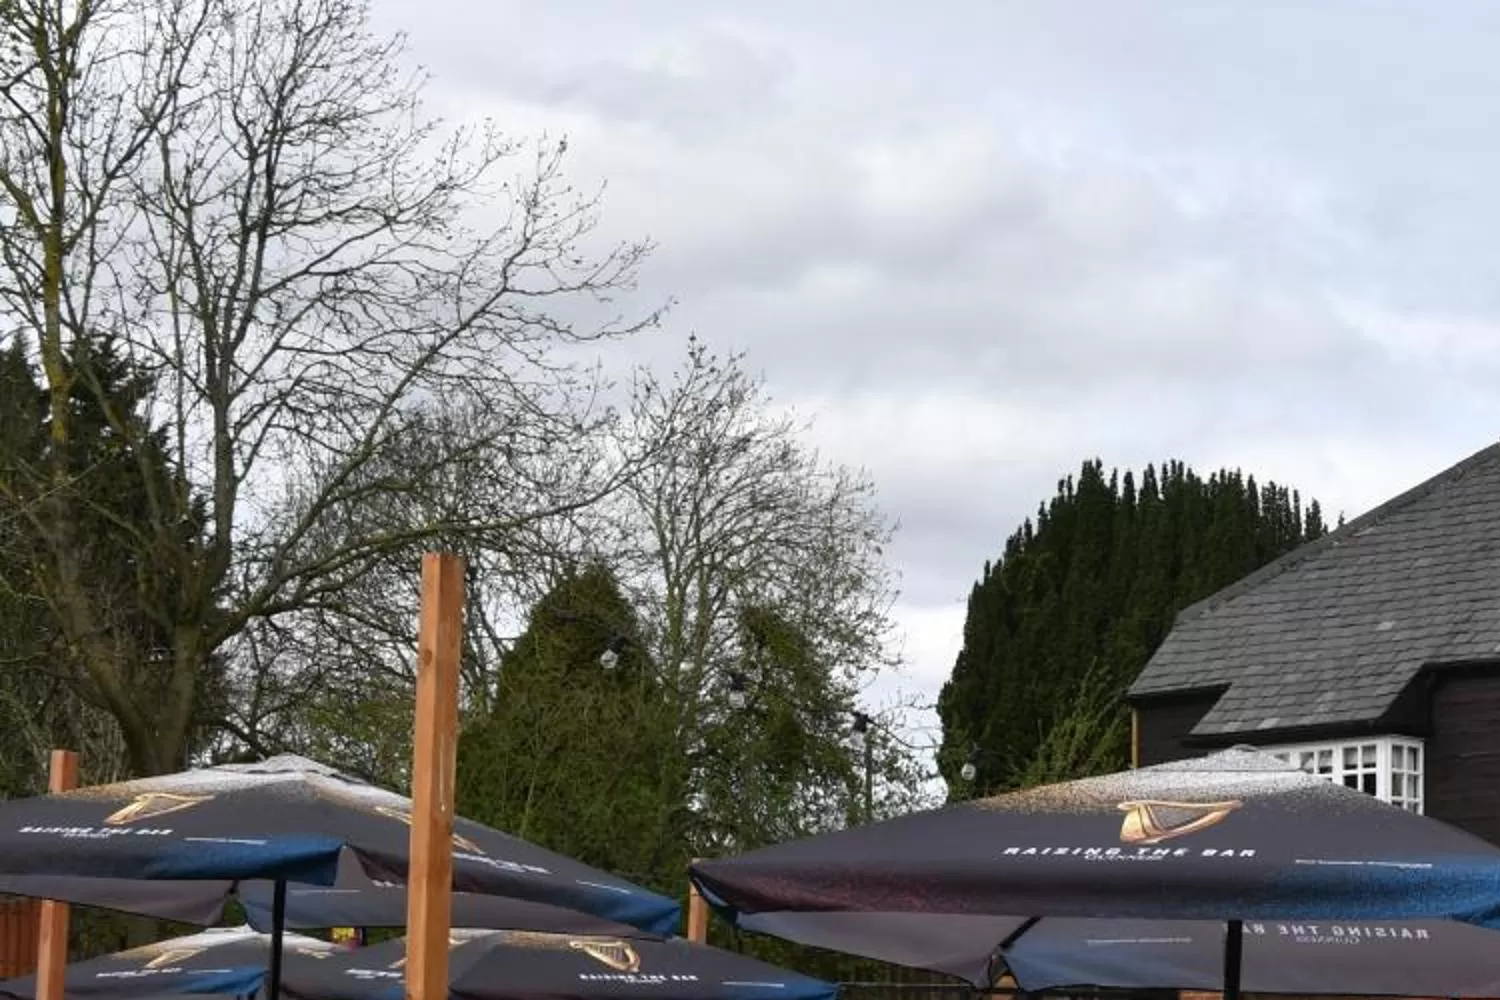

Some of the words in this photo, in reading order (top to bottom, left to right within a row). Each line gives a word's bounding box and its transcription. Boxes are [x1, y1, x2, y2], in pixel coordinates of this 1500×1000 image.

[1003, 847, 1121, 856] RAISING
[1136, 848, 1189, 856] THE
[1201, 849, 1256, 857] BAR
